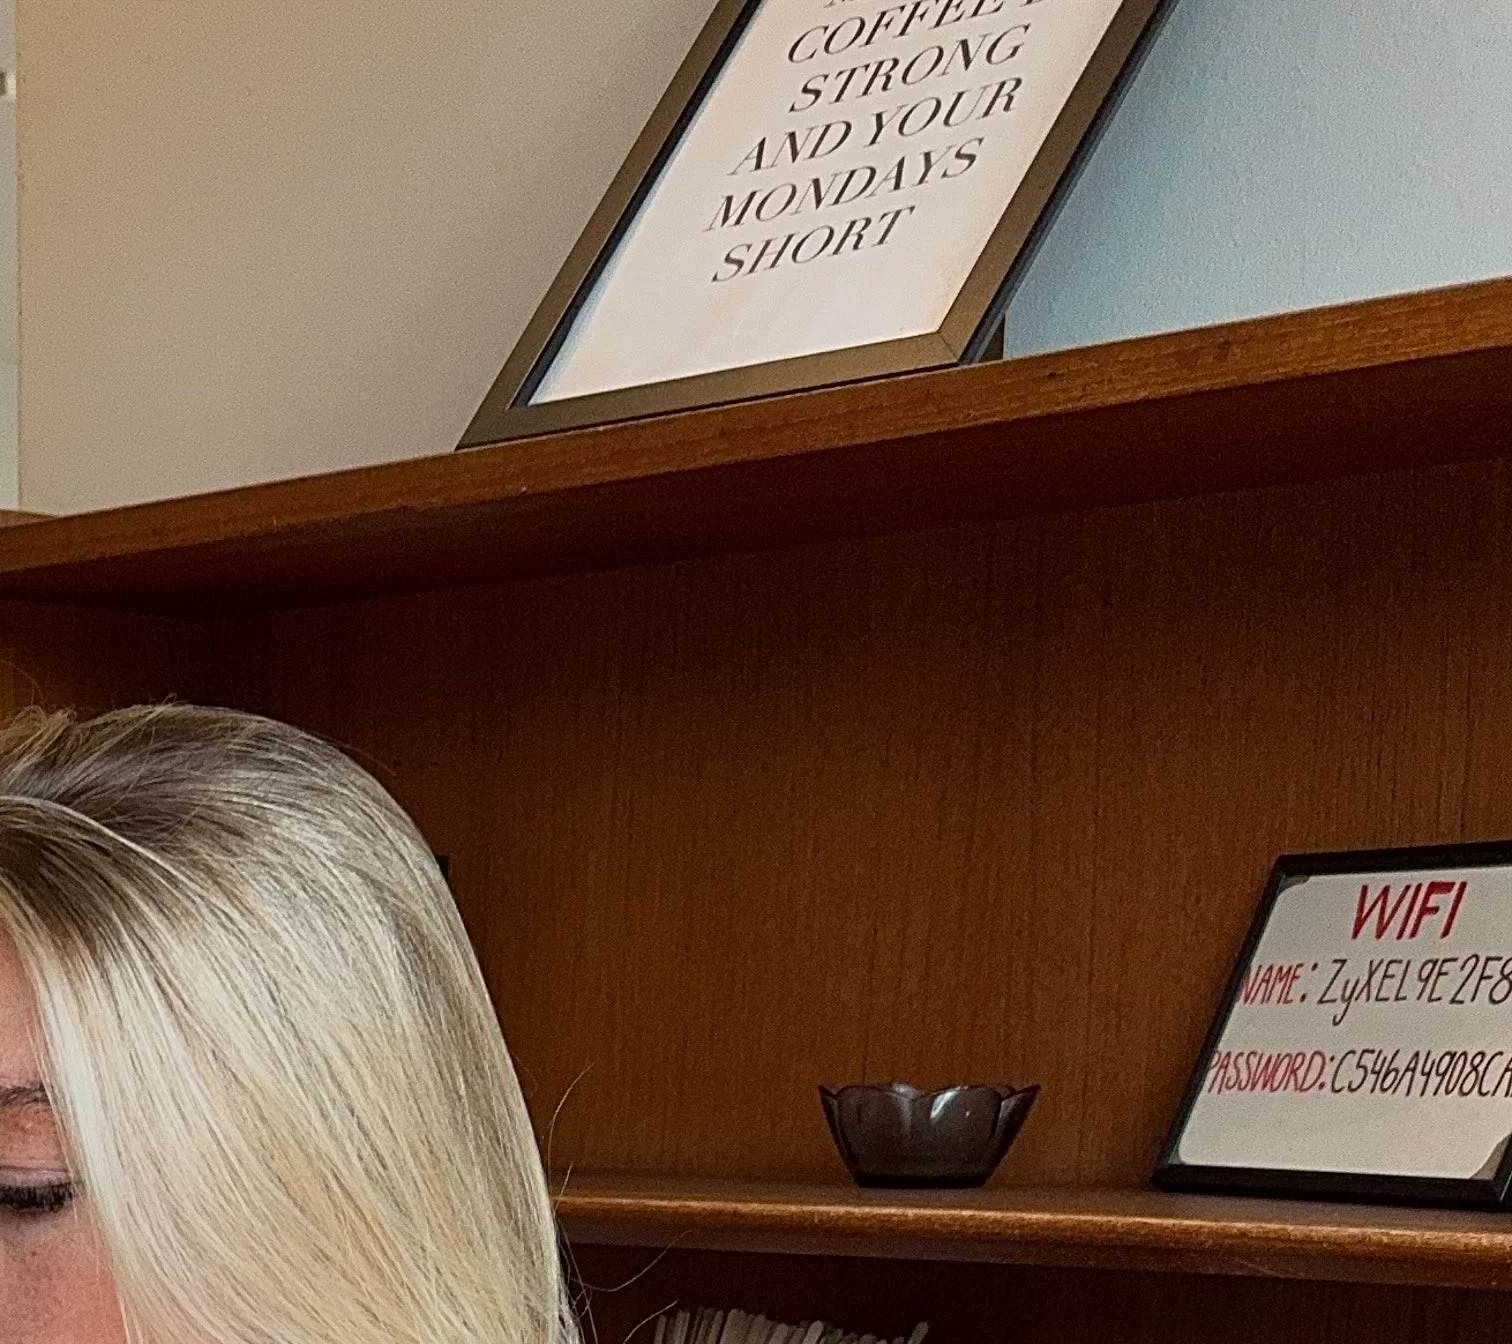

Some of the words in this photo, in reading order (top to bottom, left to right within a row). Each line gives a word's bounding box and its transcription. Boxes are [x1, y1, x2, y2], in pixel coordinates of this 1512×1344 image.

[788, 23, 1032, 113] STRONG
[728, 119, 852, 175] AND
[863, 77, 1024, 148] YOUR
[703, 137, 985, 232] MONDAYS
[711, 206, 916, 283] SHORT
[1351, 881, 1468, 941] WIFI
[1241, 962, 1319, 1006] NAME:
